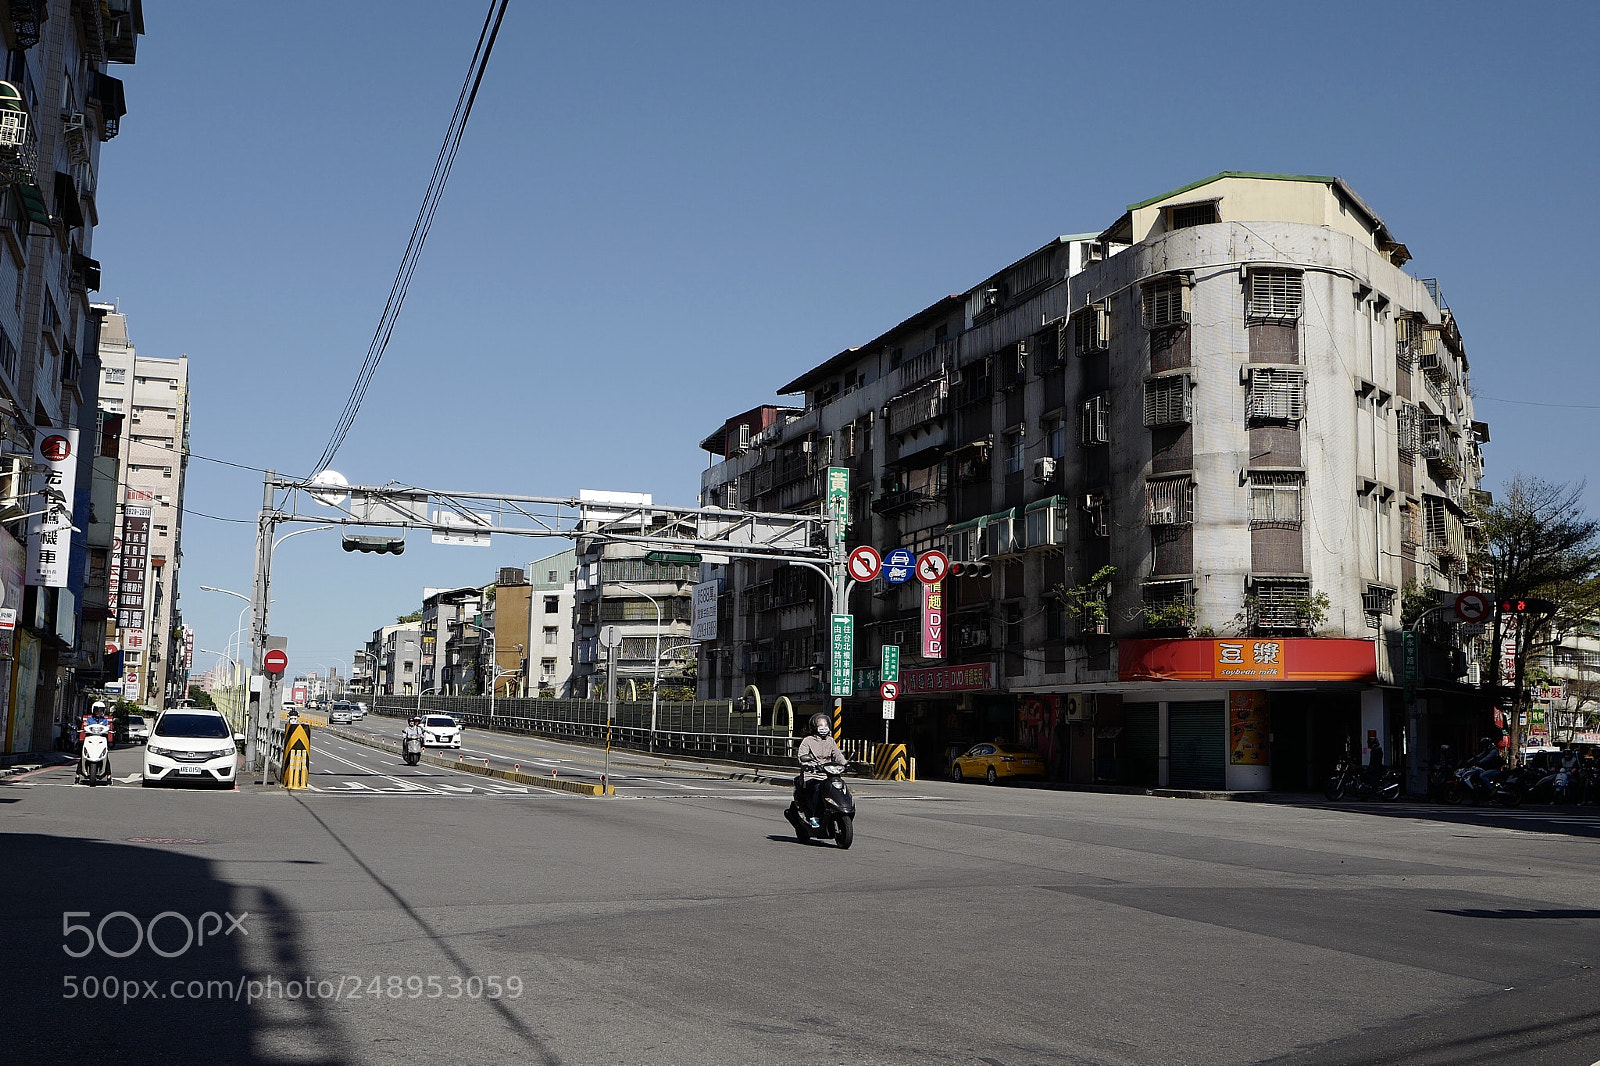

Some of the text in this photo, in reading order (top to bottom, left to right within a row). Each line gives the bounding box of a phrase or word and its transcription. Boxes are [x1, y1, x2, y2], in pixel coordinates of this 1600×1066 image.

[929, 614, 941, 653] DVD
[1218, 642, 1281, 664] 豆漿
[833, 624, 842, 694] 由成功路引道上橋
[842, 625, 851, 694] 往台北機車請右轉
[1221, 668, 1257, 676] soybean
